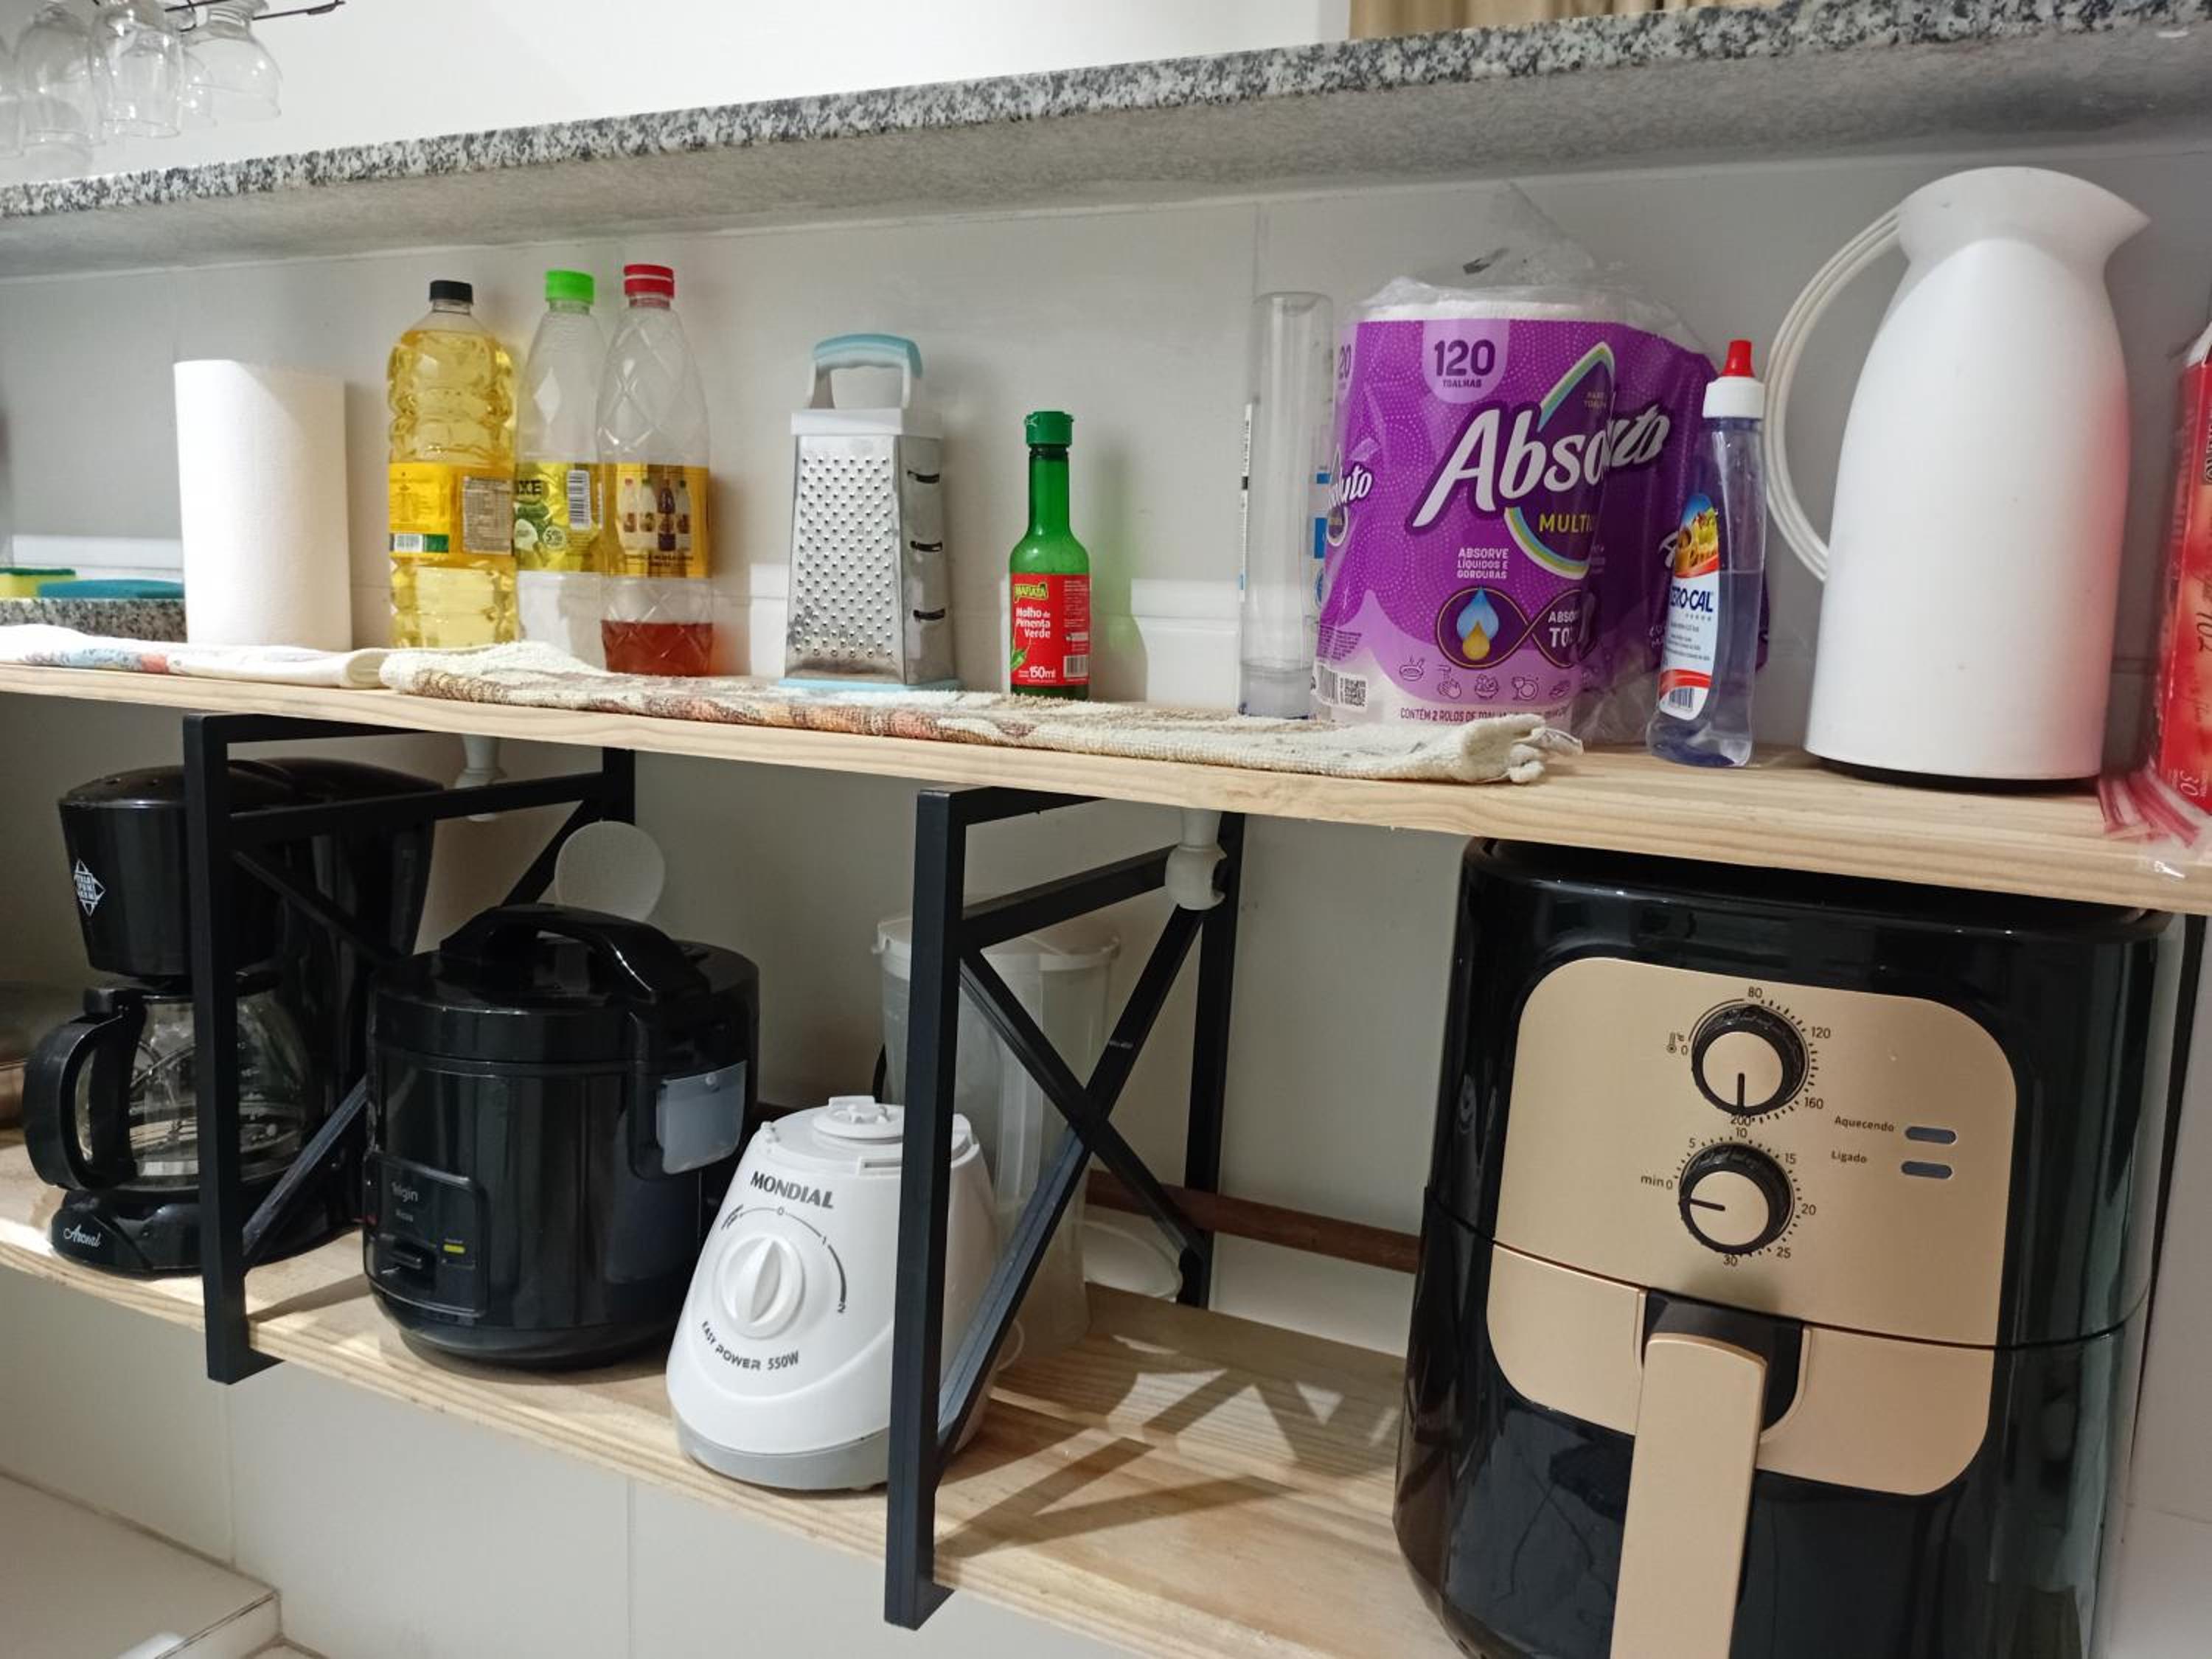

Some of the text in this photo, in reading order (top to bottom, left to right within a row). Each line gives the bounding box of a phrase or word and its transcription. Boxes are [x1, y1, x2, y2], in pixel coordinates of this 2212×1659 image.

[1434, 339, 1496, 377] 120
[1458, 548, 1509, 560] ABSORVE
[1502, 560, 1508, 569] E
[1015, 607, 1042, 617] Molho
[1015, 618, 1051, 628] Pimenta
[1023, 629, 1051, 639] Verde
[1432, 709, 1438, 721] 2
[1747, 987, 1763, 999] 80
[1812, 1027, 1831, 1039] 120
[1680, 1045, 1688, 1056] 0
[1805, 1097, 1824, 1110] 160
[1731, 1116, 1751, 1127] 200
[1834, 1116, 1894, 1133] Aquecendo
[1736, 1127, 1747, 1138] 10
[1688, 1138, 1696, 1149] 5
[1785, 1153, 1796, 1165] 15
[1832, 1150, 1868, 1164] Ligado
[1641, 1174, 1673, 1190] min 0
[750, 1171, 834, 1209] MONDIAL
[776, 1206, 785, 1216] 0
[1801, 1204, 1816, 1217] 20
[1777, 1246, 1792, 1259] 25
[1723, 1256, 1738, 1267] 30
[838, 1303, 846, 1313] 2
[714, 1343, 761, 1371] POWER
[768, 1351, 799, 1370] 550W
